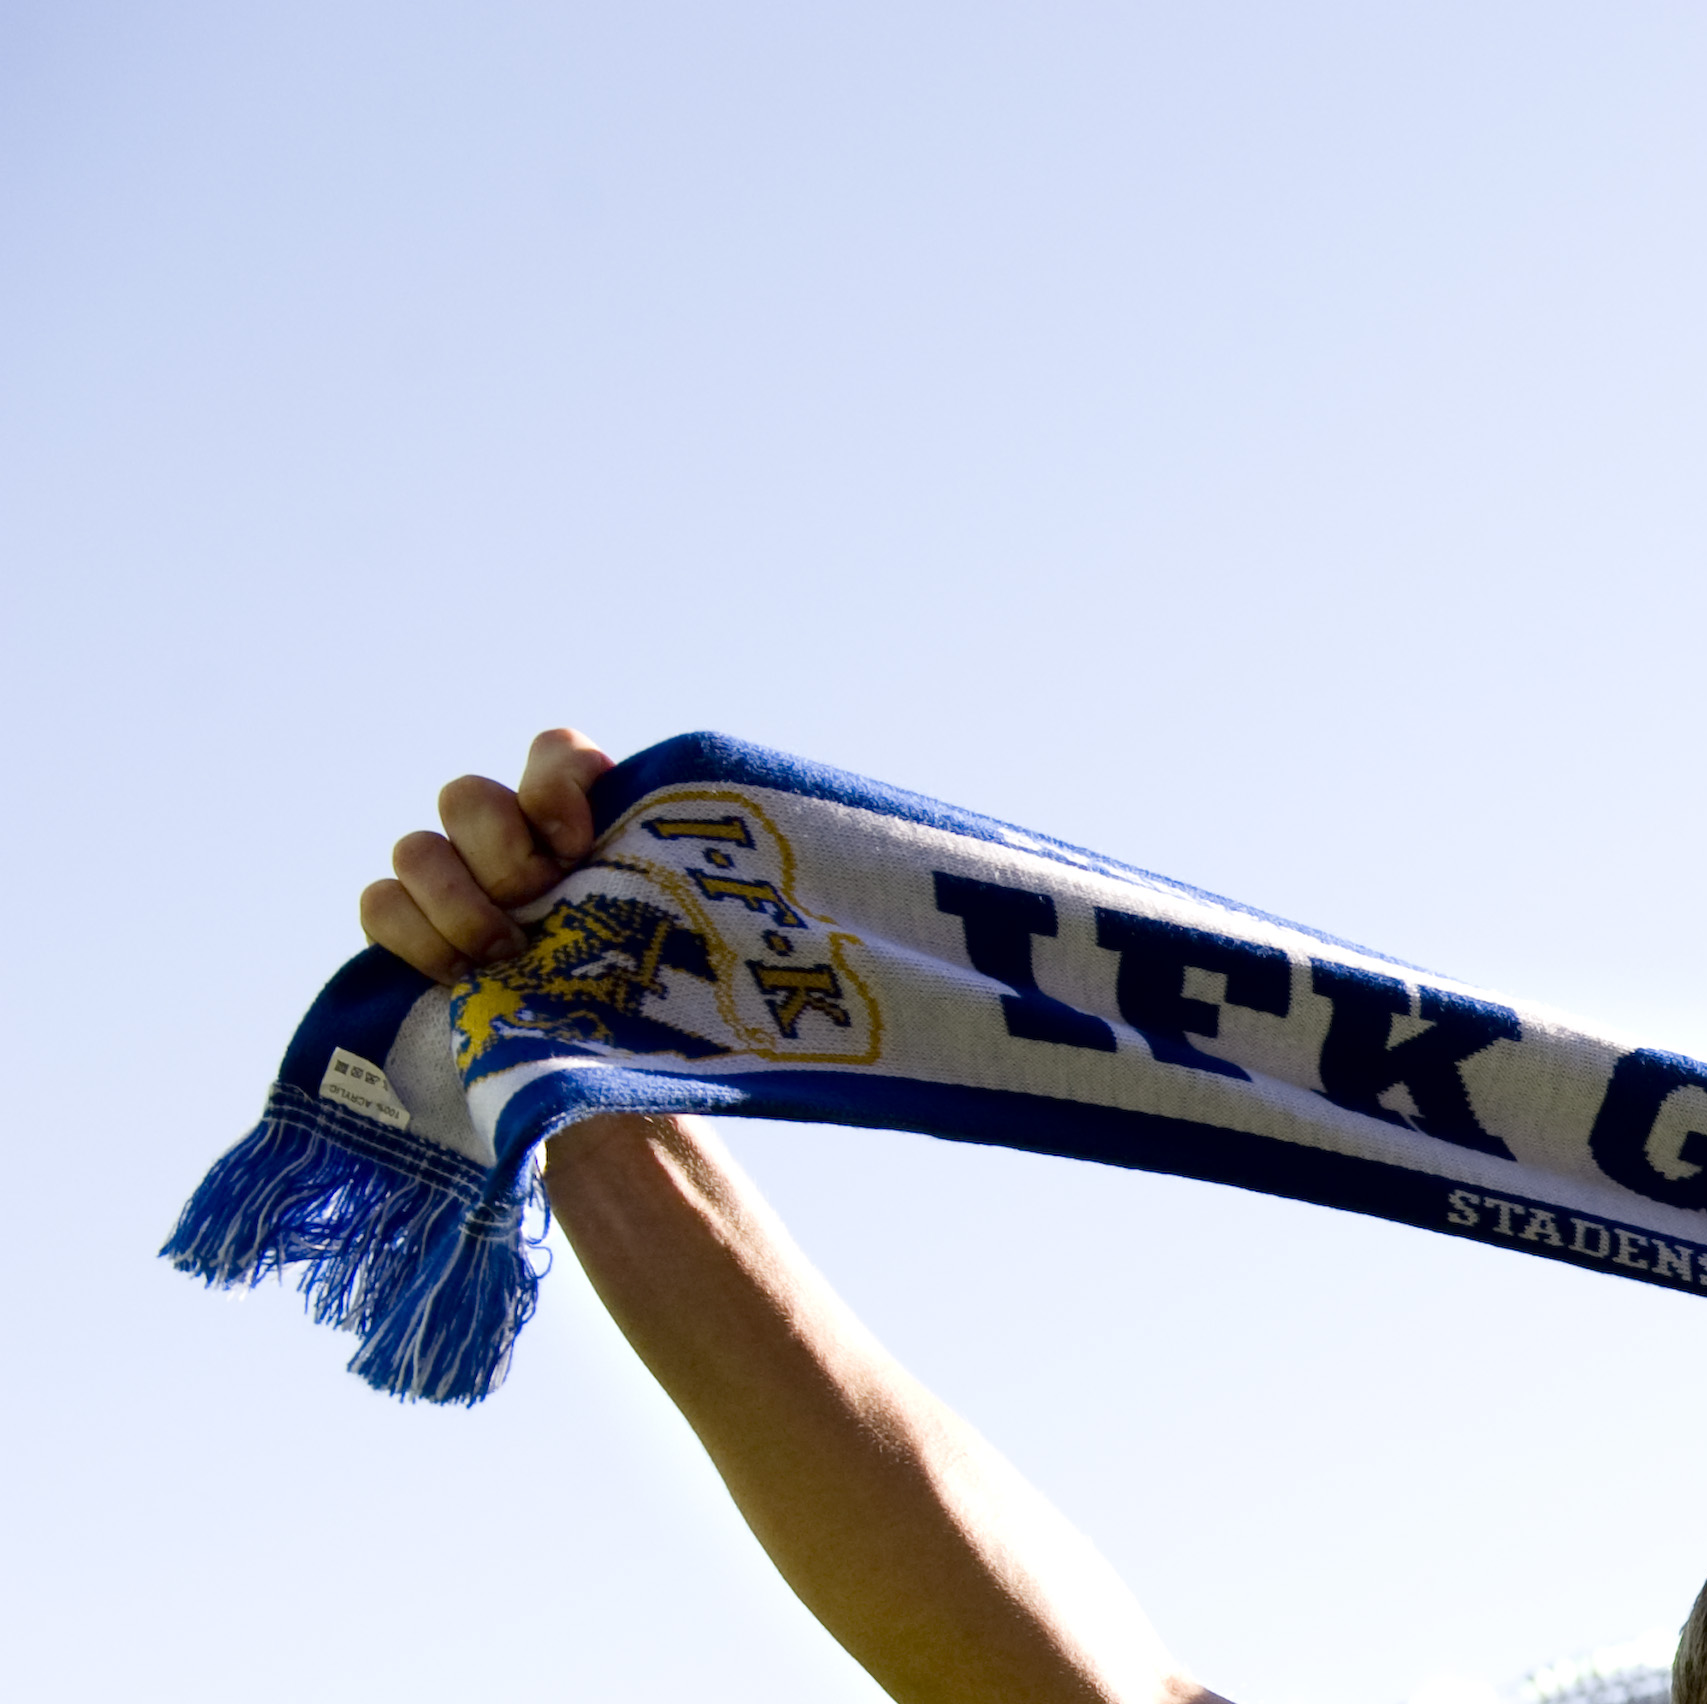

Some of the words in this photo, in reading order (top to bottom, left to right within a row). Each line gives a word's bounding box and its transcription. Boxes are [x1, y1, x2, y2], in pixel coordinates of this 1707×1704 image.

[932, 871, 1522, 1162] IFK
[328, 1084, 373, 1109] ACRYLIC
[375, 1101, 401, 1120] 100%
